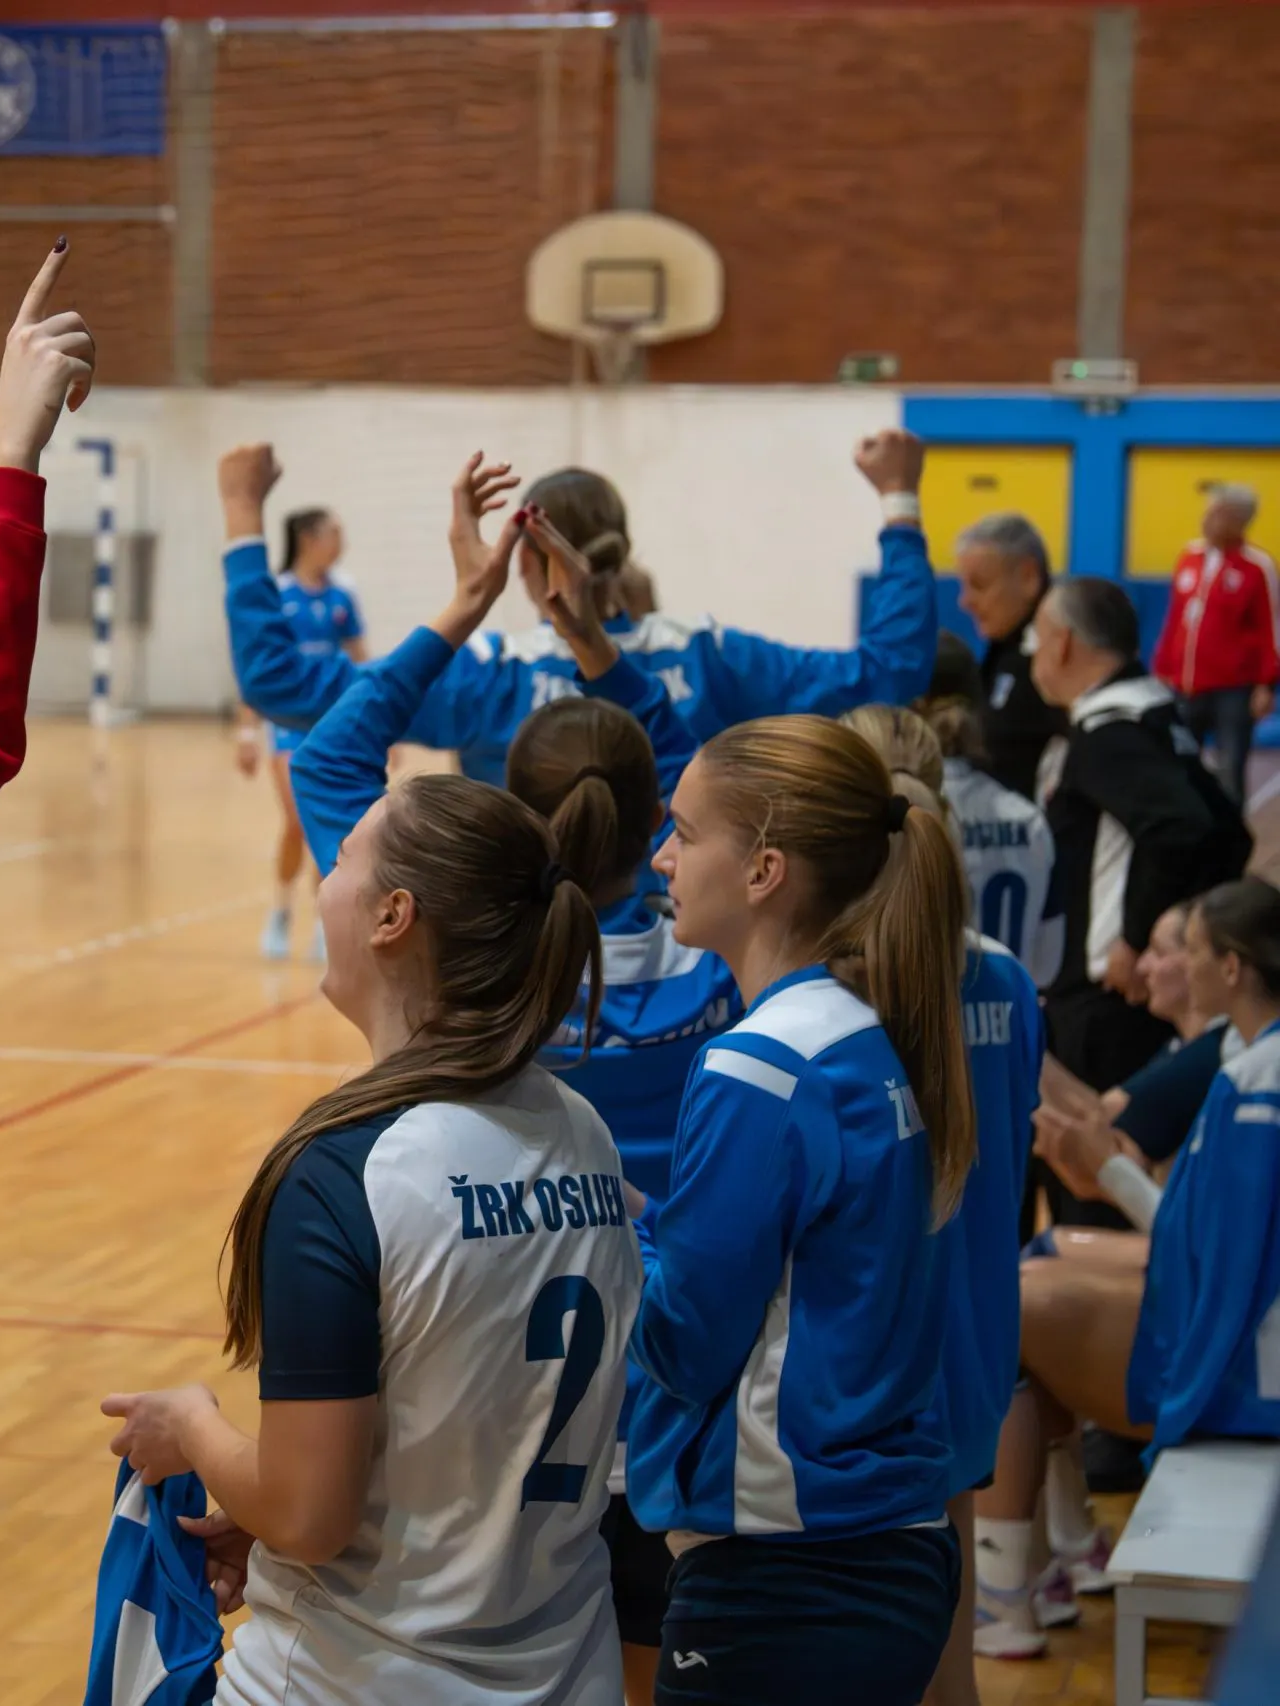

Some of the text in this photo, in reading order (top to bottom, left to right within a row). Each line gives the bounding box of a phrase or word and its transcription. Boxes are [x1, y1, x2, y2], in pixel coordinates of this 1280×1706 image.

[448, 1173, 626, 1240] ŽRK OSIJEK
[520, 1275, 606, 1512] 2
